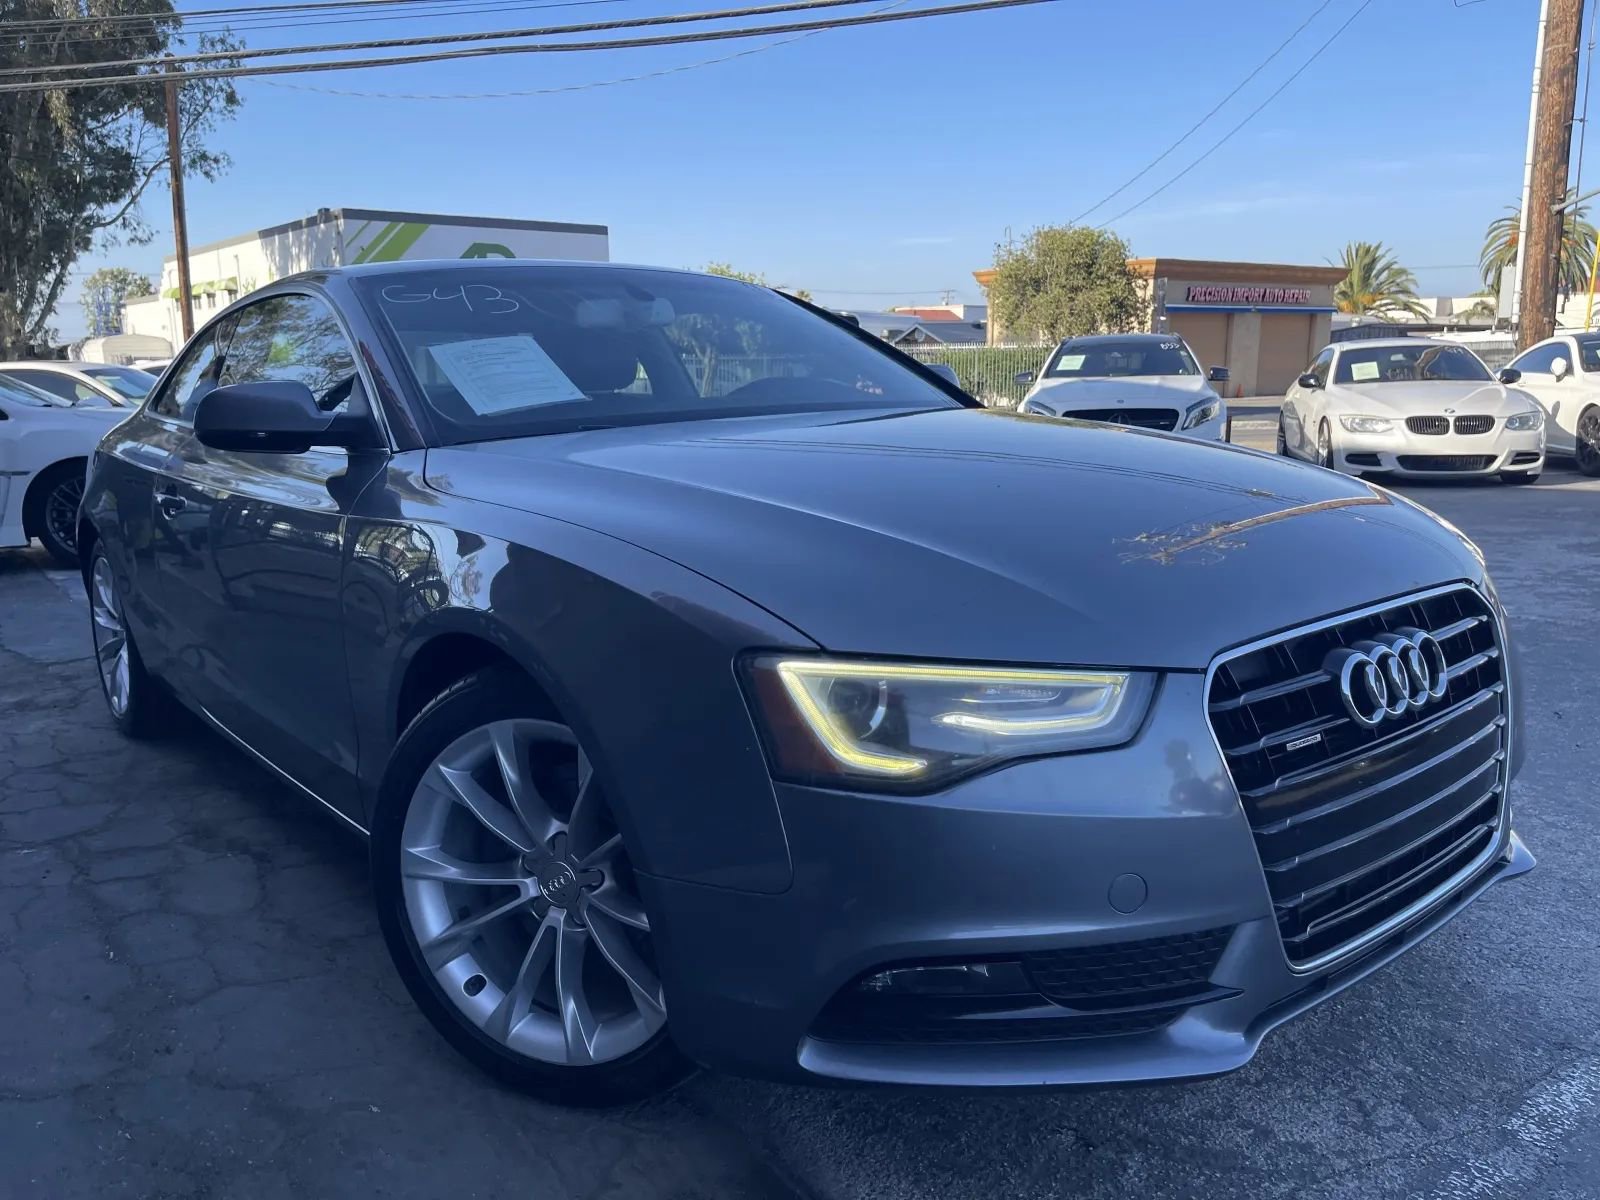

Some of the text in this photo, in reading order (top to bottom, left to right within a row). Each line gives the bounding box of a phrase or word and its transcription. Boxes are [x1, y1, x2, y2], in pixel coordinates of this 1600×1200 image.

[381, 284, 520, 314] G43
[1188, 286, 1311, 303] PRECISION IMPORT AUTO REPAIR
